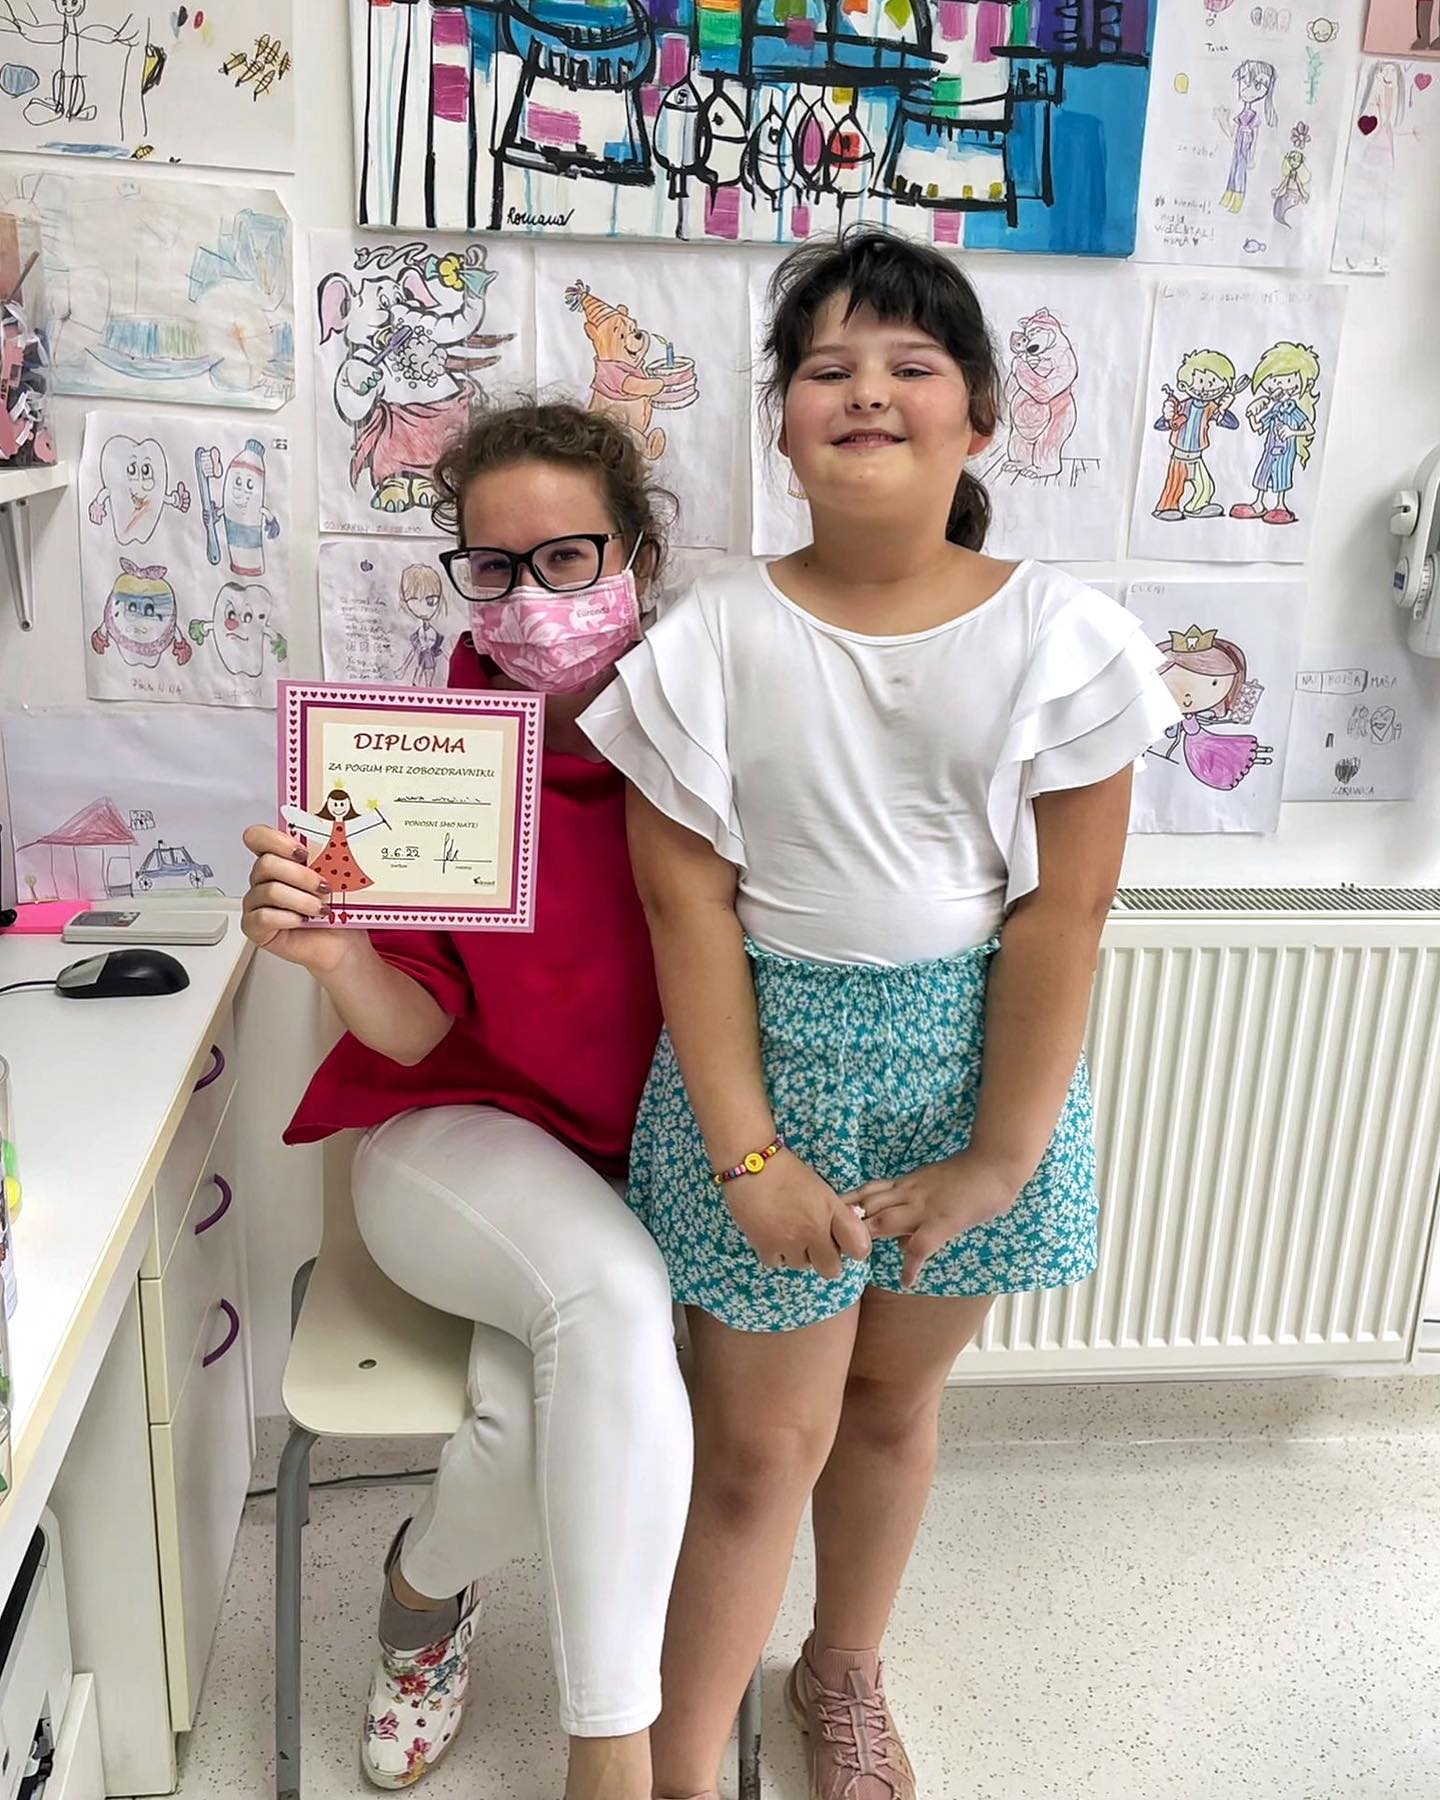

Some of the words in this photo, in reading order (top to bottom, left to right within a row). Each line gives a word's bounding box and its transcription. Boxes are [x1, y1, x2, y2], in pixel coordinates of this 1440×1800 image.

[353, 733, 466, 754] DIPLOMA
[328, 762, 342, 771] ZA
[345, 763, 383, 774] POGUM
[385, 765, 403, 774] PRI
[406, 766, 496, 778] ZOBOZDRAVNIKU
[404, 820, 438, 828] PONOSNI
